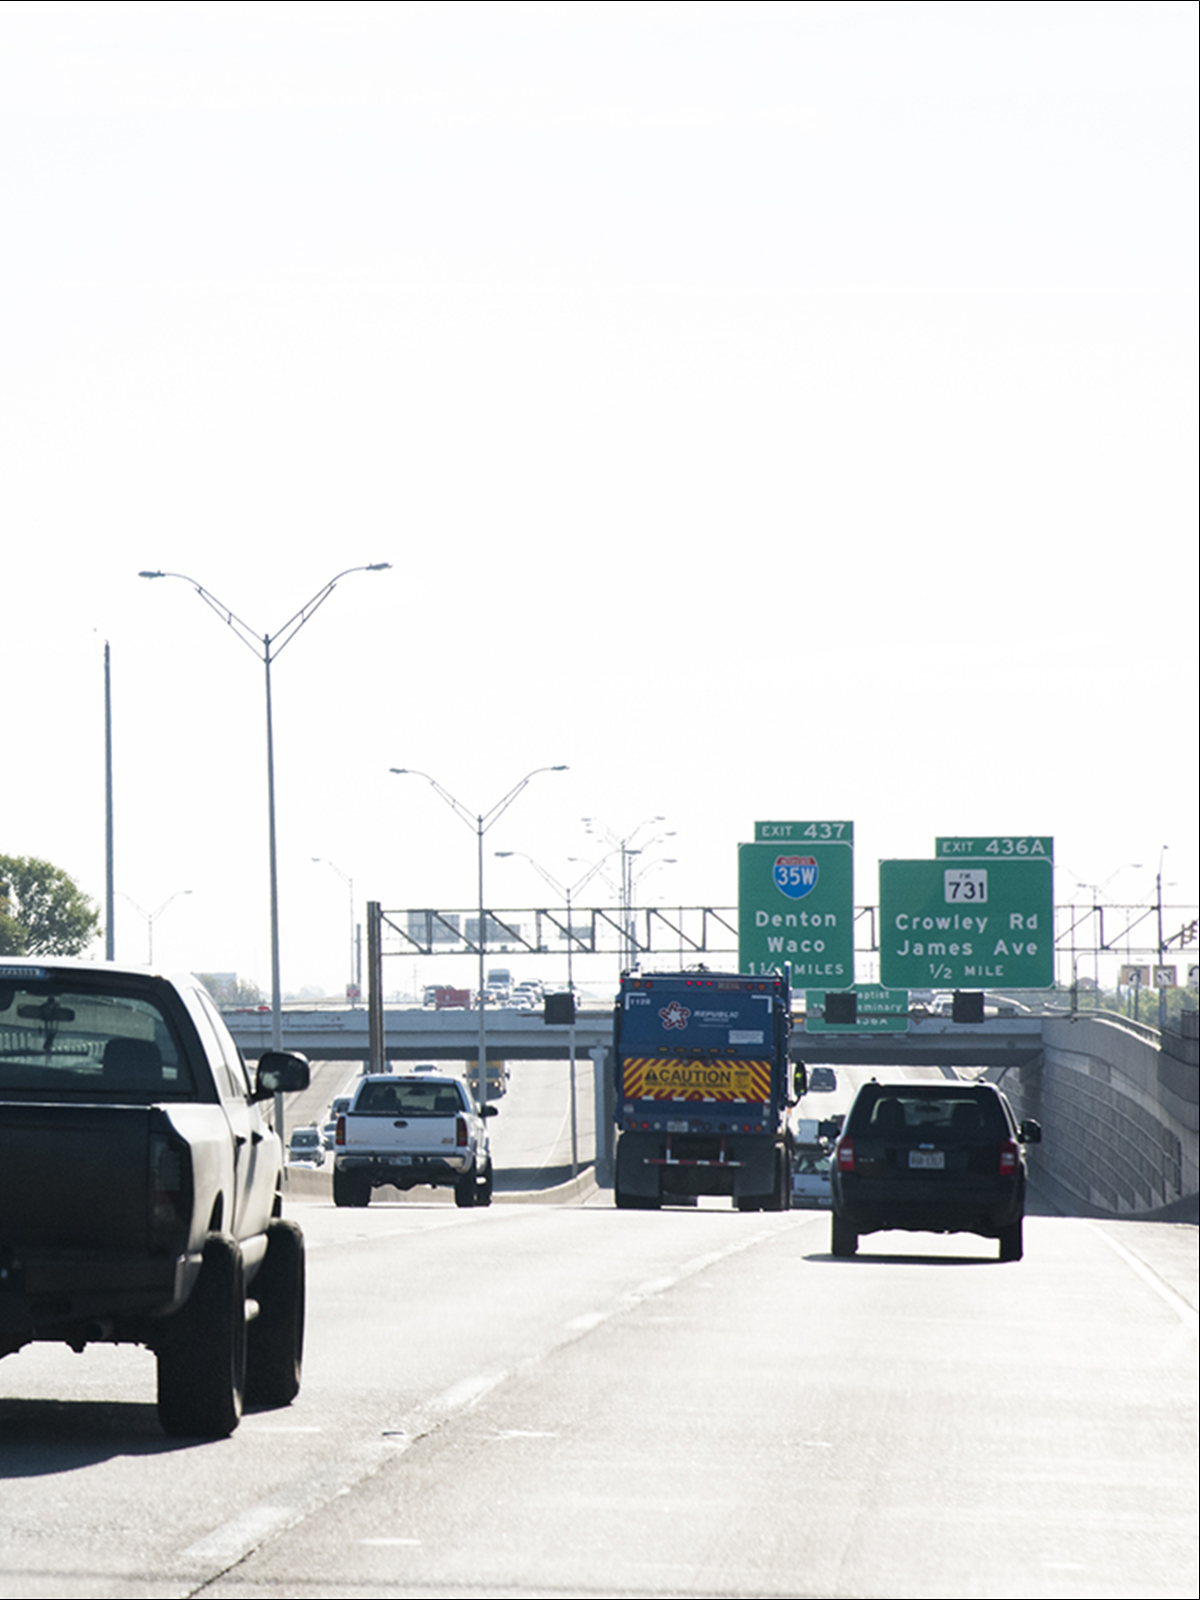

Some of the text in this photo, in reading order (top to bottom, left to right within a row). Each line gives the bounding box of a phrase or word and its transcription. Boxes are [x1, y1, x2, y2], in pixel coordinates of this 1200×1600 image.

[761, 823, 845, 839] EXIT 437
[942, 839, 1046, 855] EXIT 436A
[777, 867, 815, 886] 35W
[948, 881, 985, 900] 731
[755, 910, 837, 927] Denton
[895, 913, 1038, 934] Crowley Rd
[767, 936, 826, 953] Waco
[896, 939, 1038, 956] James Ave
[794, 964, 844, 975] MILES
[929, 963, 1004, 979] 1/2 MILE
[850, 990, 890, 1000] aptist
[693, 1010, 739, 1019] REPUBLIC
[857, 1003, 902, 1012] eminary
[659, 1069, 731, 1084] CAUTION
